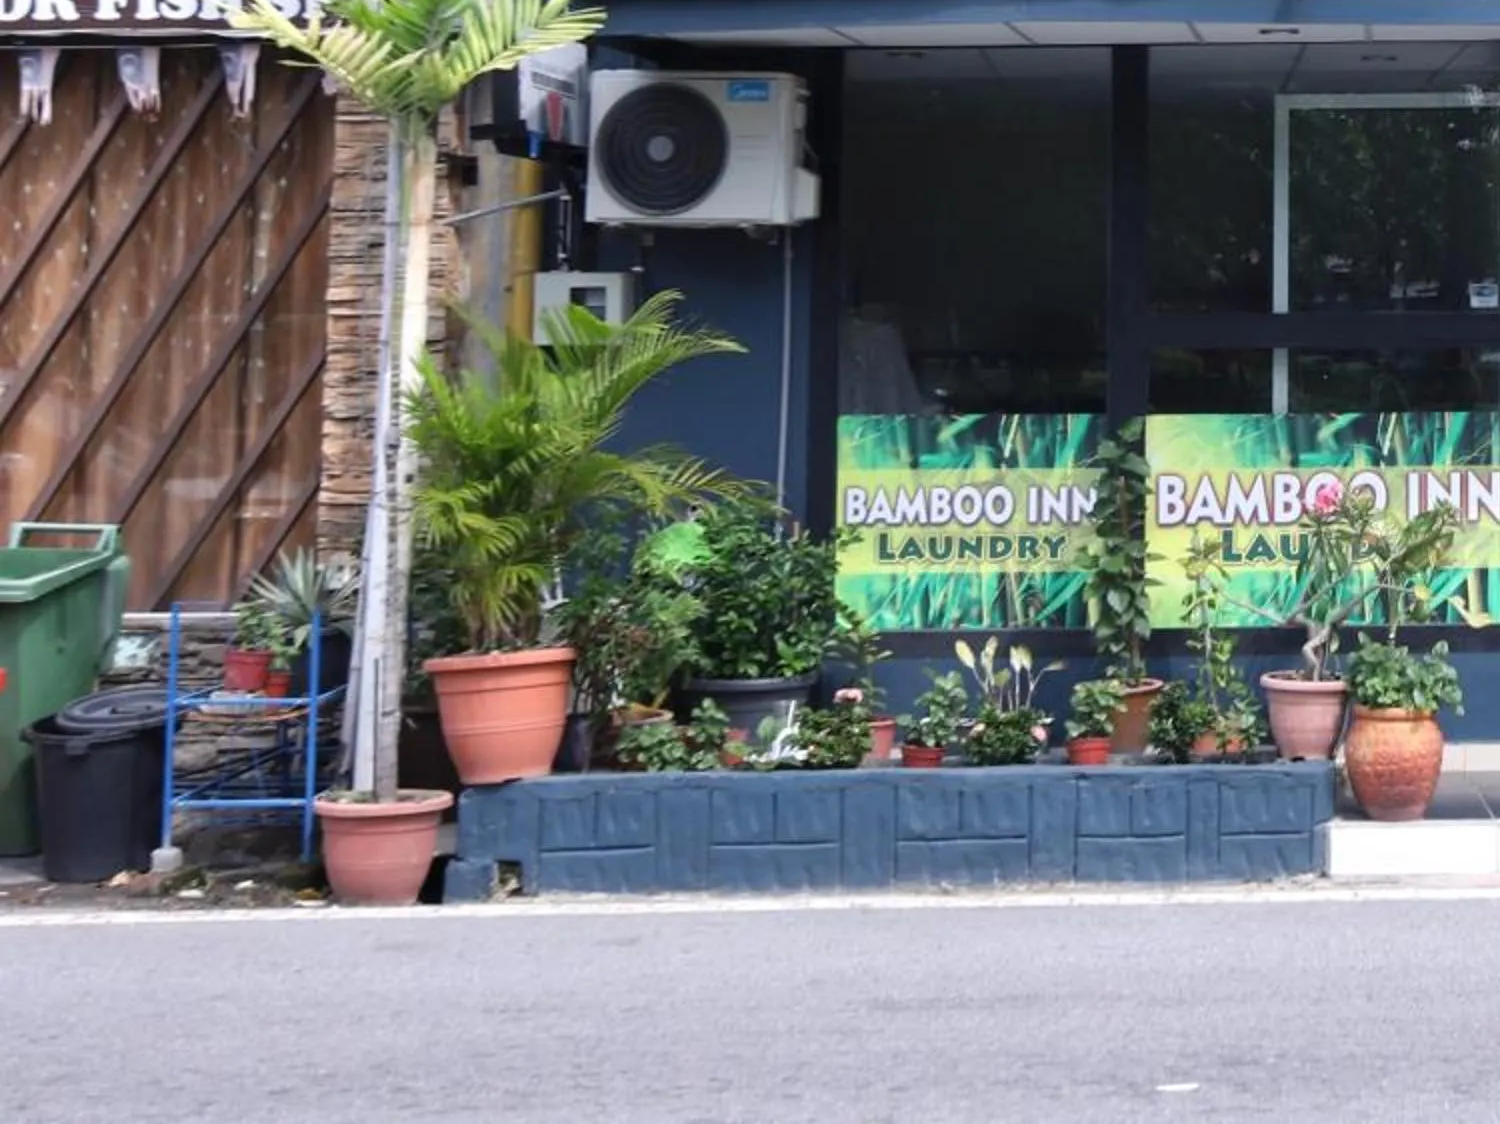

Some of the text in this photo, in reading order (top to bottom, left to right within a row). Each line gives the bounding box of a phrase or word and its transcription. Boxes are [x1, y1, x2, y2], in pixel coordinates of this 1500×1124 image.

[844, 485, 1098, 526] BAMBOO INN
[878, 532, 1067, 562] LAUNDRY
